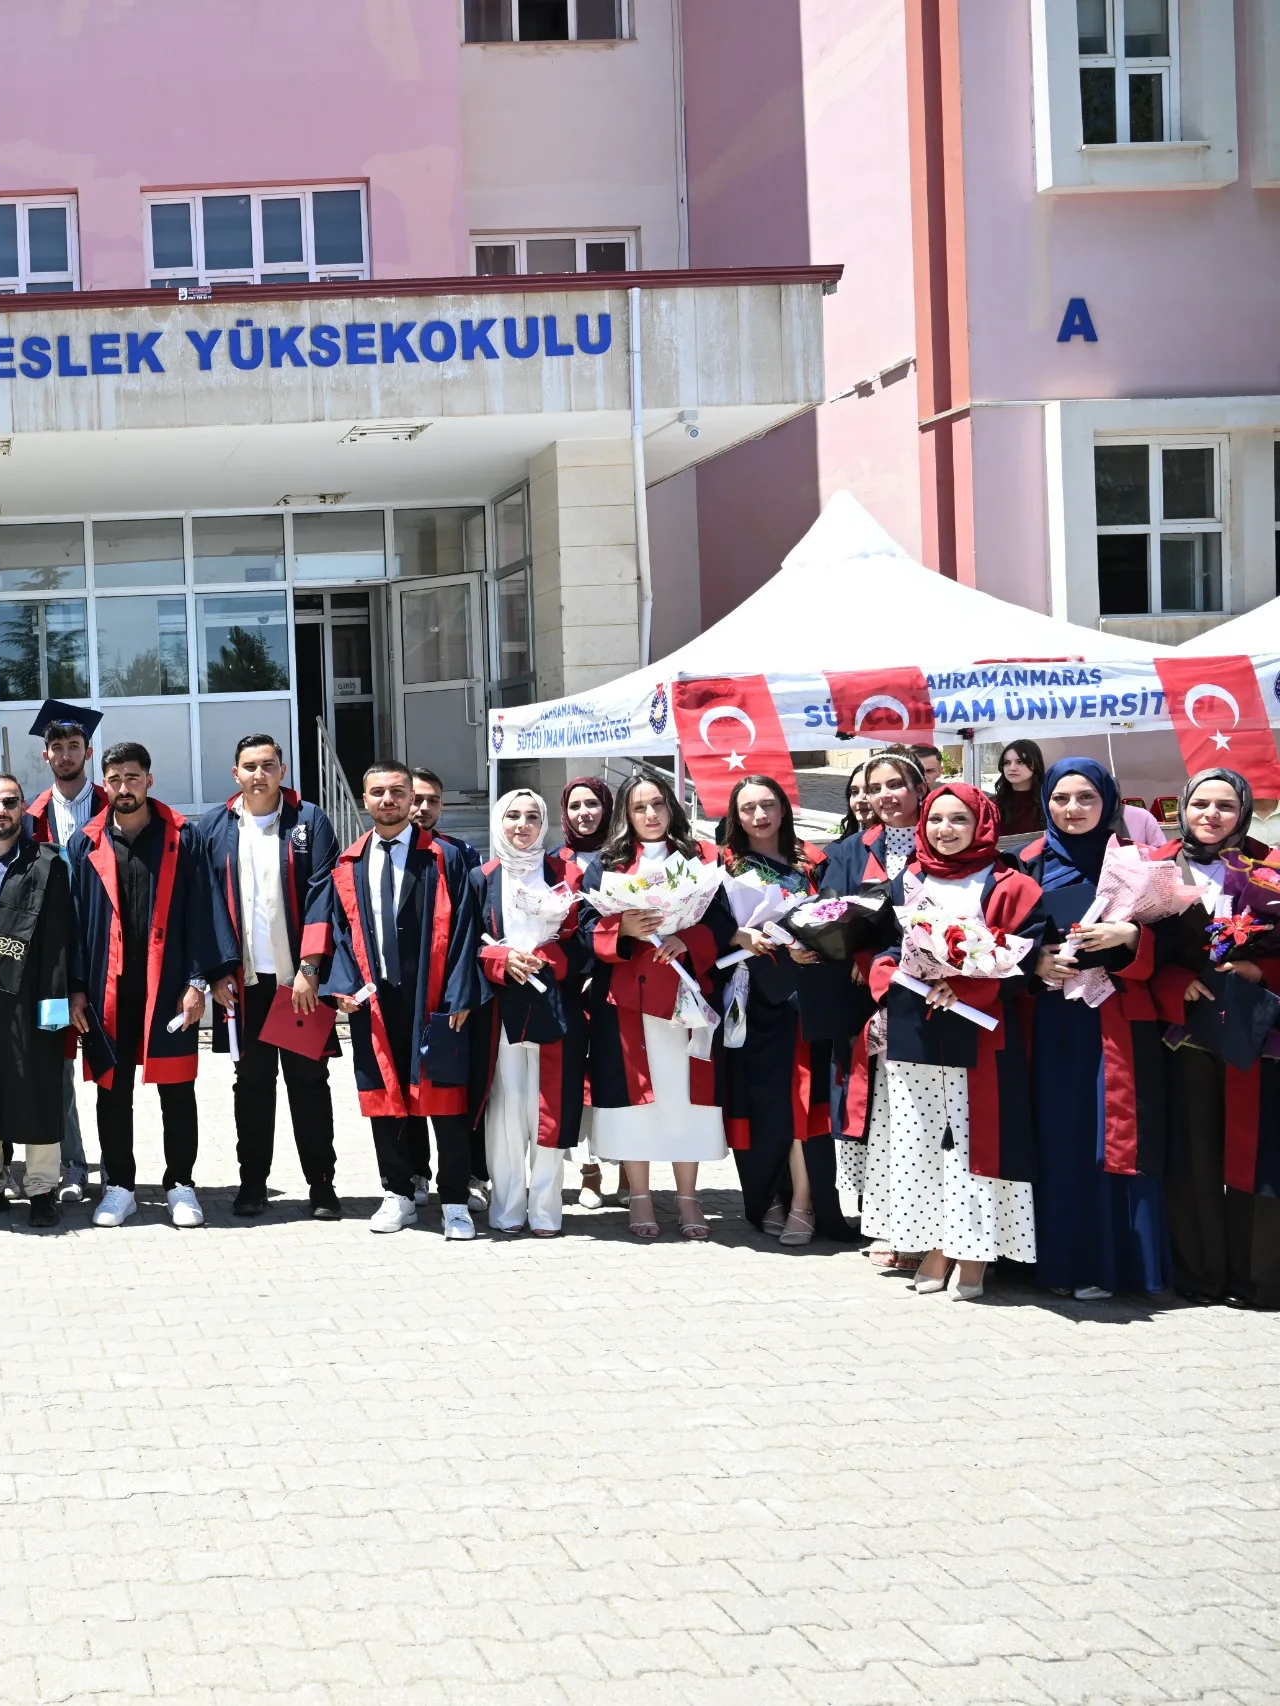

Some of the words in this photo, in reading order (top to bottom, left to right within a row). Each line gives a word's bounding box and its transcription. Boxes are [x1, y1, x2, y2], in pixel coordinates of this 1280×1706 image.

[185, 313, 612, 371] YÜKSEKOKULU
[1056, 298, 1098, 342] A
[516, 726, 541, 754] SÜTÇÜ
[542, 725, 565, 749] İMAM
[566, 712, 632, 747] ÜNİVERSİTESİ
